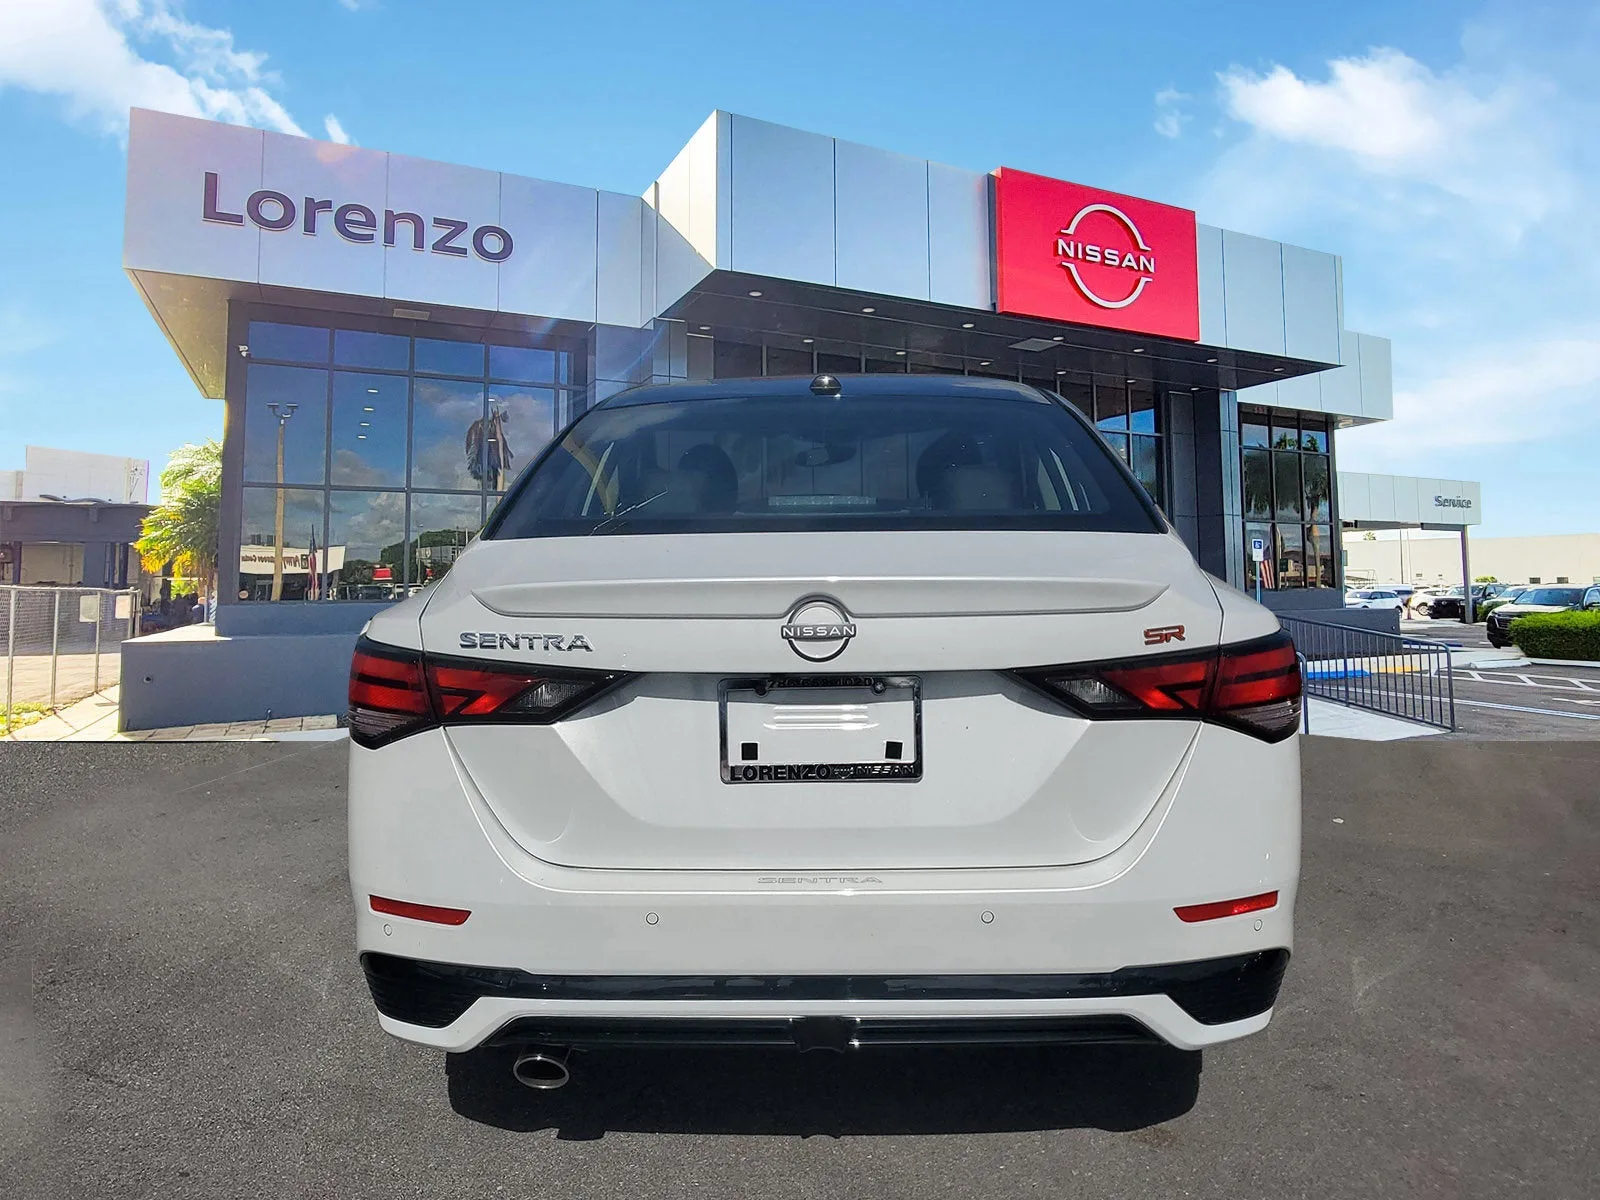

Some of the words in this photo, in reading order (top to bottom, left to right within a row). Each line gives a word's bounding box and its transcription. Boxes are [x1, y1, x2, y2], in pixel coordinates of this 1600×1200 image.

[202, 170, 514, 263] Lorenzo
[1057, 238, 1156, 273] NISSAN
[1434, 495, 1472, 509] Service
[781, 625, 856, 637] NISSAN
[1143, 624, 1186, 646] SR
[459, 632, 594, 652] SENTRA
[730, 764, 831, 781] LORENZO
[857, 764, 915, 775] NISSAN
[758, 876, 883, 884] SENTRA
